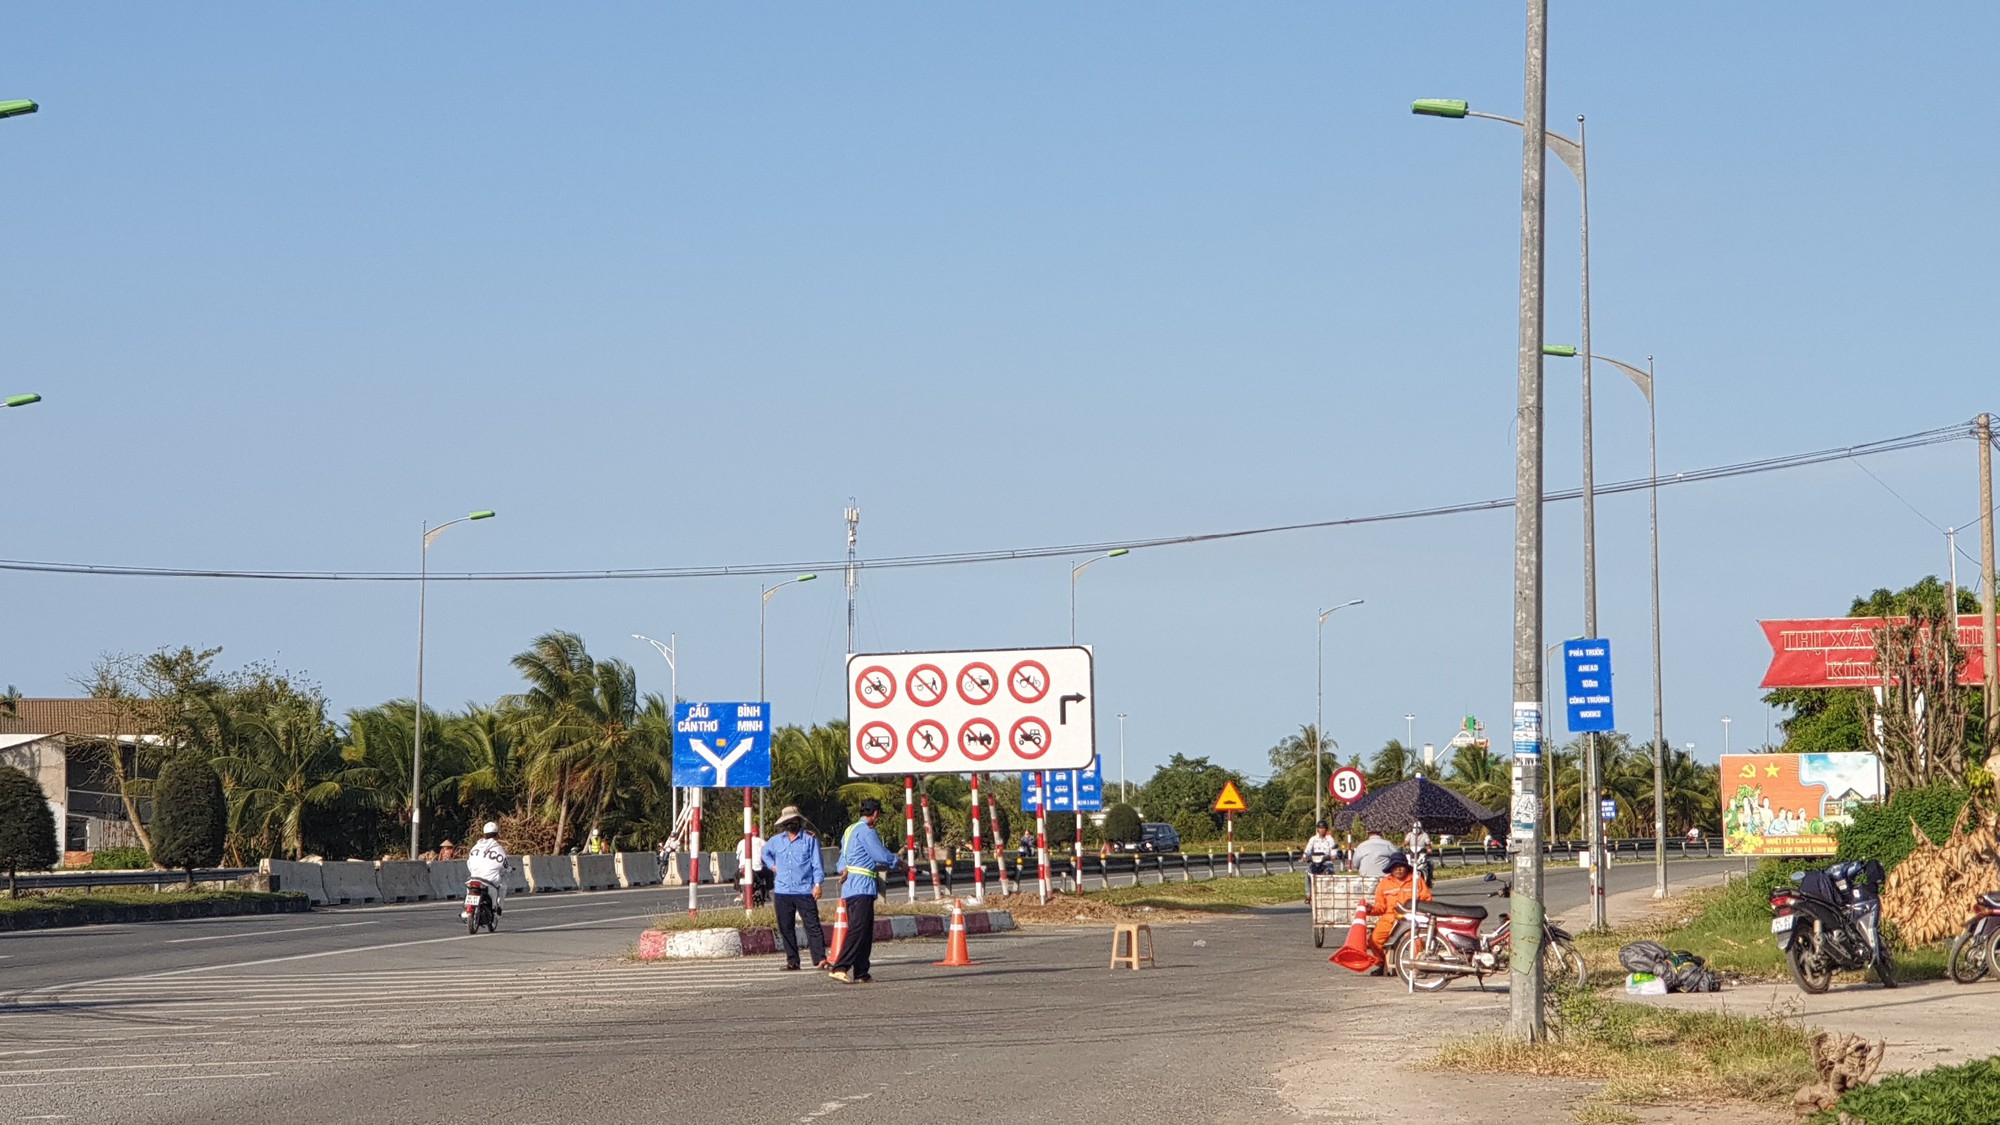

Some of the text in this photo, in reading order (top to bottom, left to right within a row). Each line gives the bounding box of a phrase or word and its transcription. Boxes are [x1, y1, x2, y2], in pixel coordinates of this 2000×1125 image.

[1578, 664, 1599, 673] AHEAD
[1579, 710, 1602, 719] WORKS
[737, 720, 763, 732] MINH
[1338, 776, 1357, 793] 50
